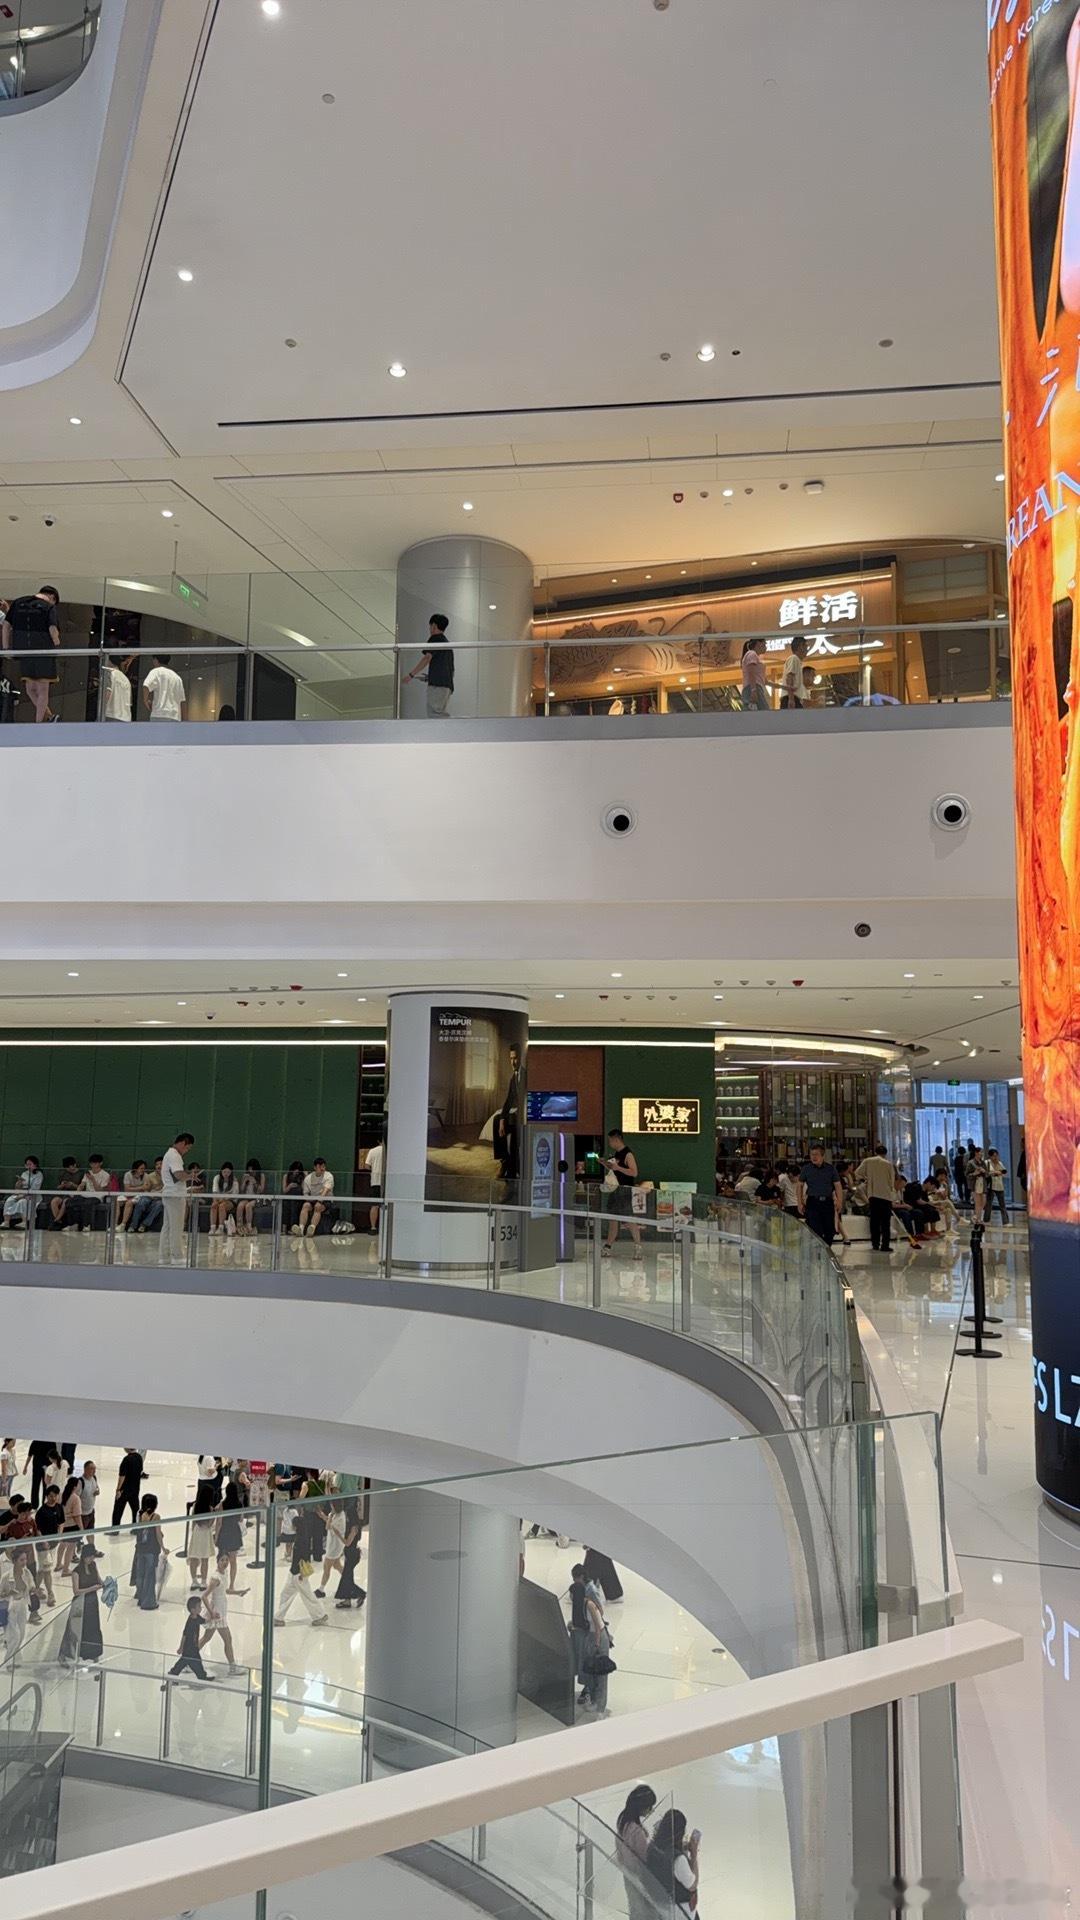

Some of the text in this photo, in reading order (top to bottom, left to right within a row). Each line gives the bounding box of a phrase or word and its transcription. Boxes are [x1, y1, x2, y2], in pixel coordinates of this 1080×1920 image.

[1017, 0, 1062, 44] Kore
[779, 590, 858, 628] 鲜活
[439, 1018, 472, 1026] TEMPUR
[643, 1101, 692, 1123] 外婆家
